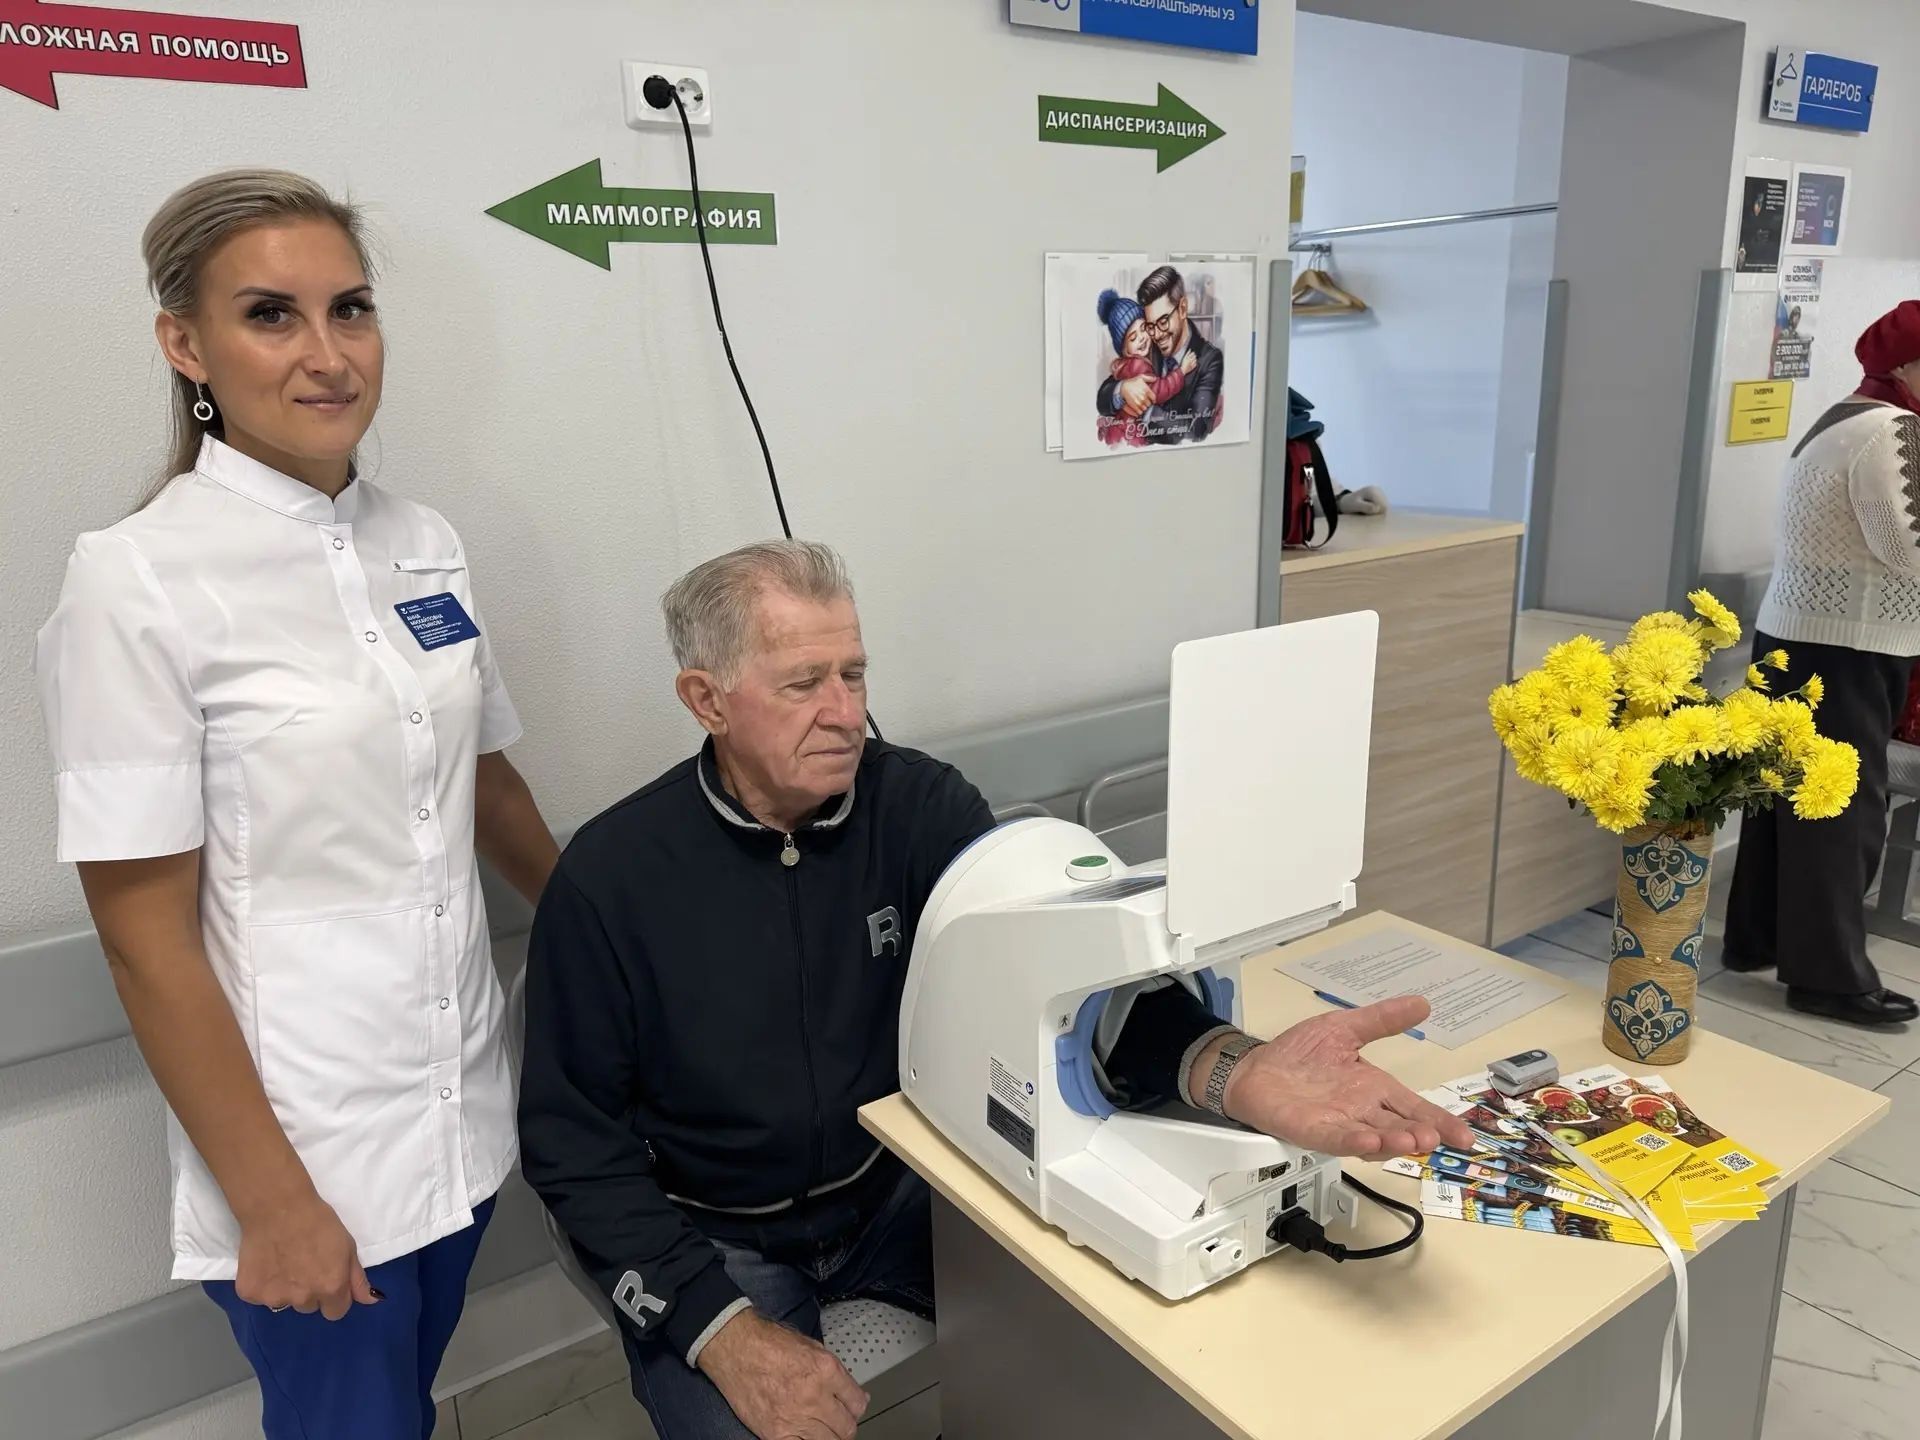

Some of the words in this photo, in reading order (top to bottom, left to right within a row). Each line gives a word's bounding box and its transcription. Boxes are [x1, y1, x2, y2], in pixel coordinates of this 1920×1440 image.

[0, 22, 140, 53] ЛОЖНАЯ
[150, 34, 290, 66] ПОМОЩЬ
[1804, 75, 1862, 103] ГАРДЕРОБ
[1045, 110, 1208, 139] ДИСПАНСЕРИЗАЦИЯ
[546, 203, 762, 229] МАММОГРАФИЯ
[866, 905, 902, 957] R
[1591, 1142, 1629, 1159] ОСНОВНЫЕ
[1600, 1147, 1639, 1165] ПРИНЦИПЫ
[1632, 1152, 1650, 1161] ЗОЖ
[1710, 1173, 1730, 1182] ЗОЖ
[612, 1270, 667, 1328] R
